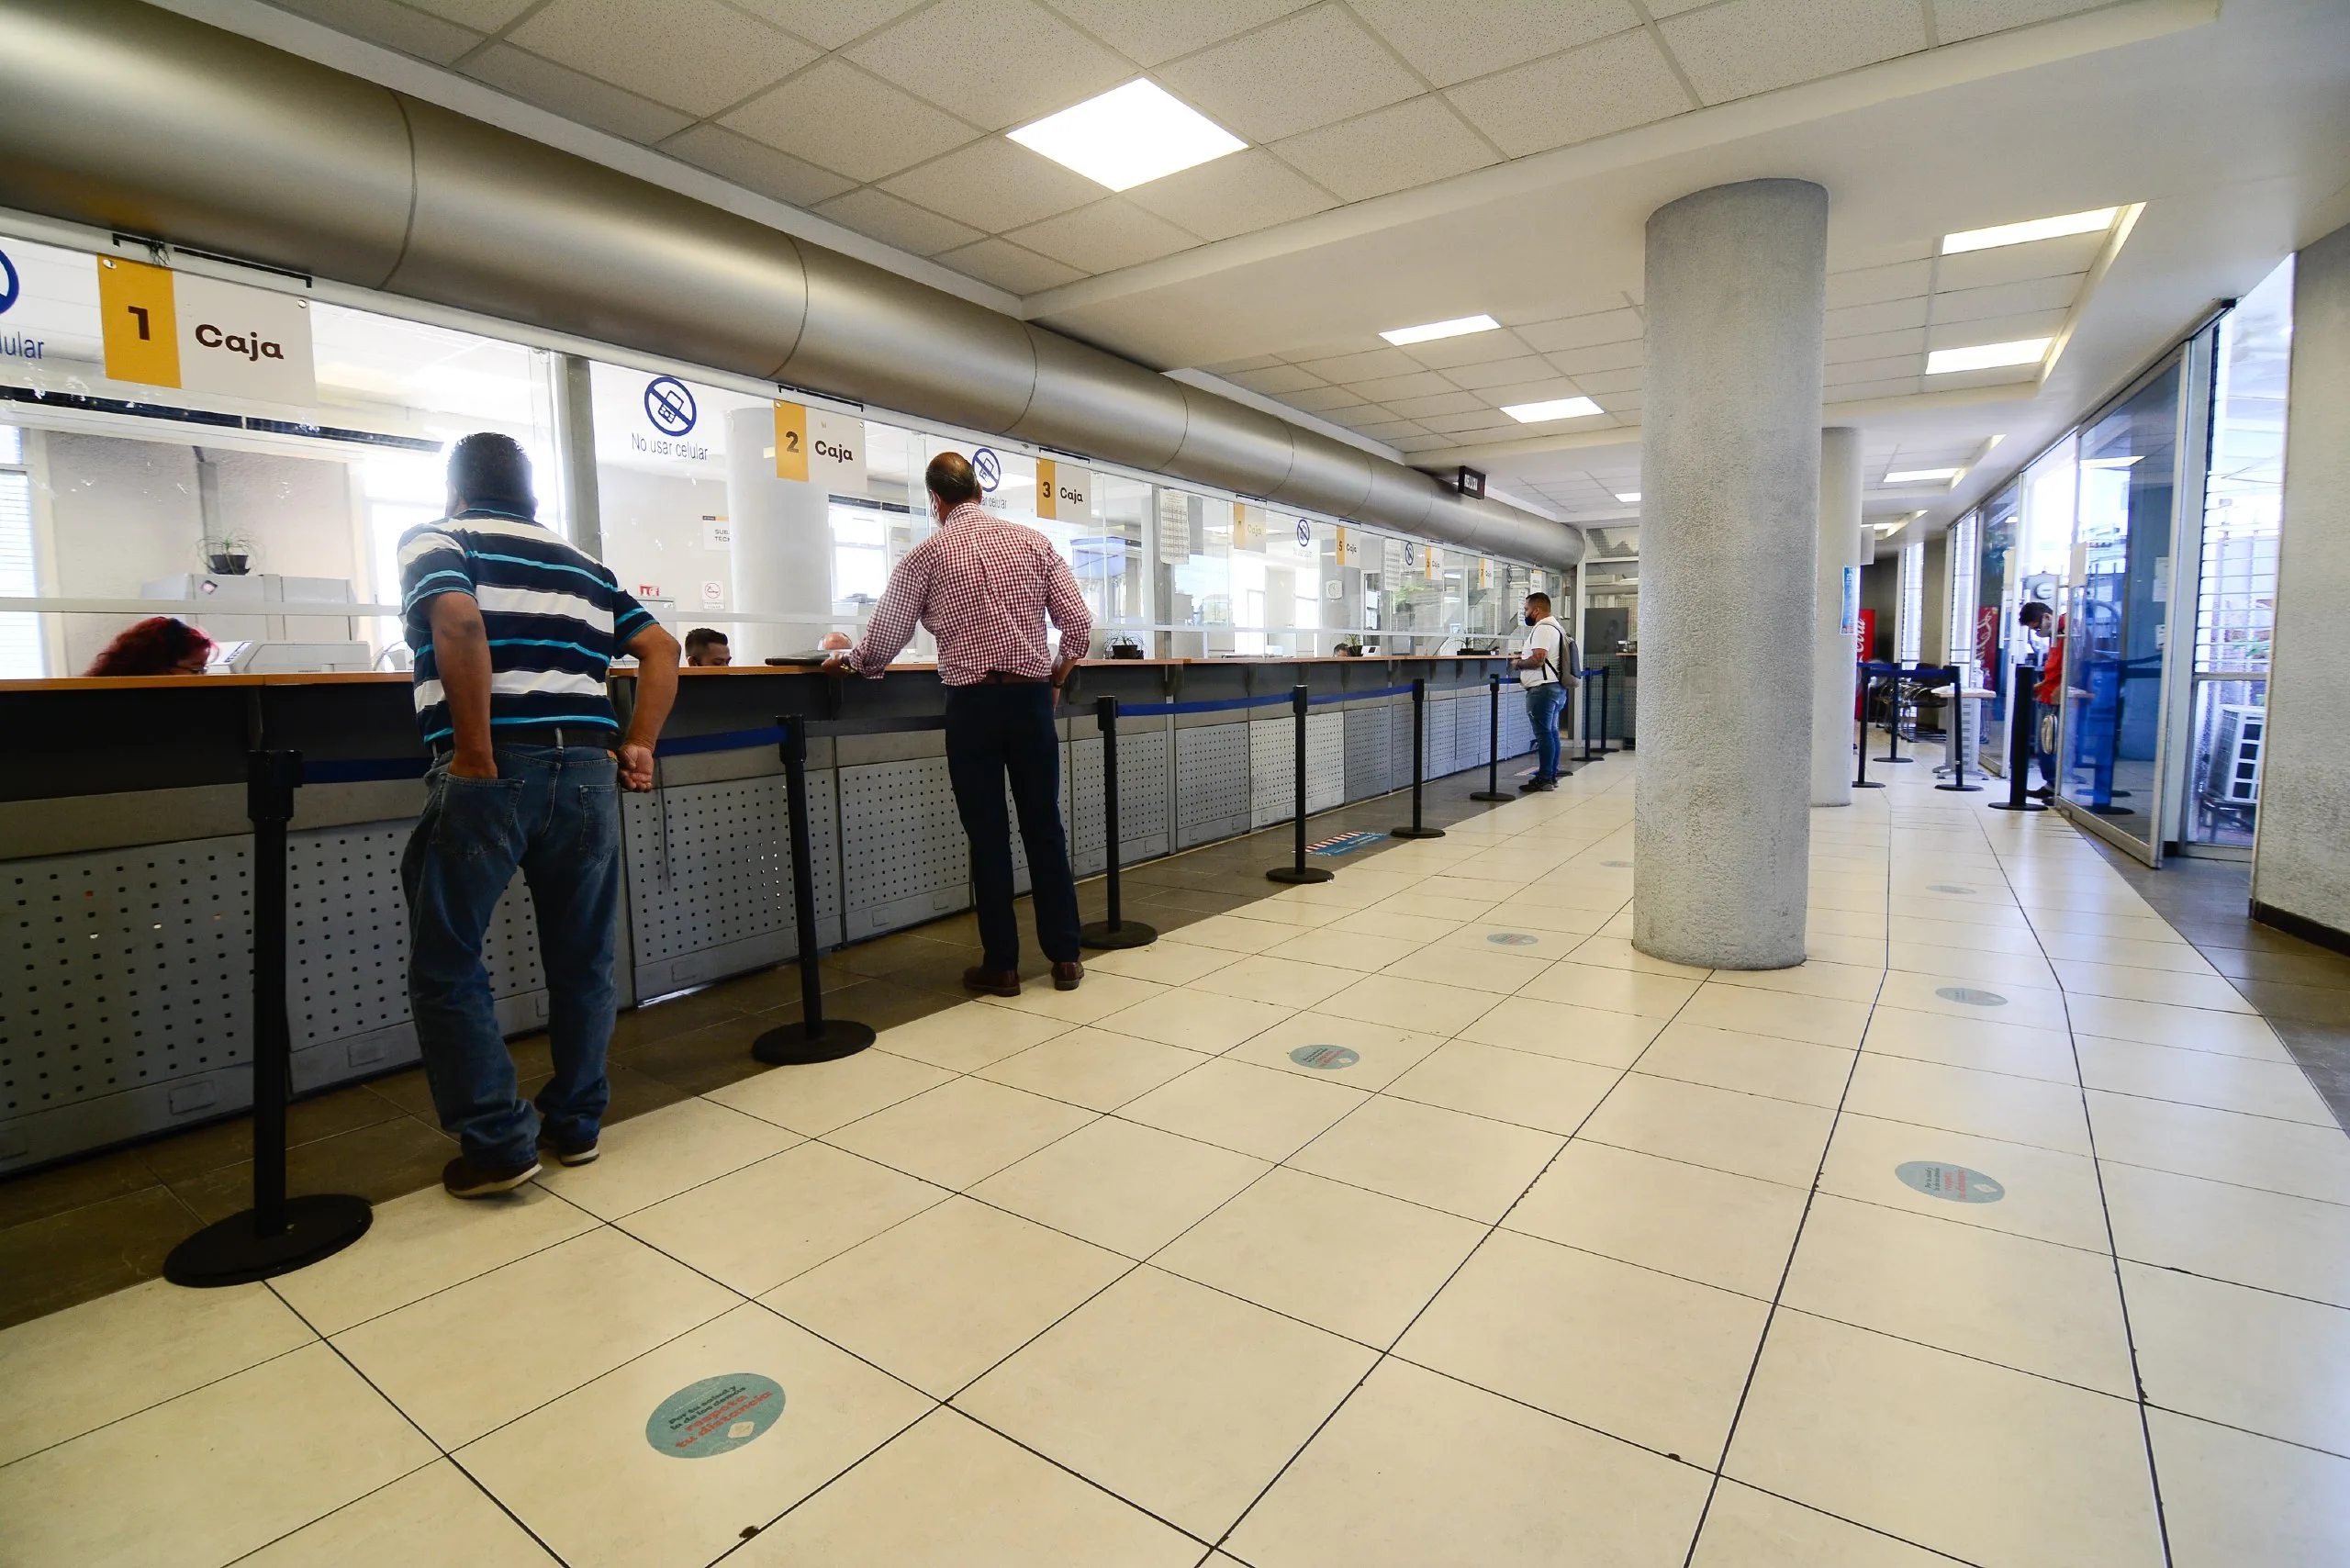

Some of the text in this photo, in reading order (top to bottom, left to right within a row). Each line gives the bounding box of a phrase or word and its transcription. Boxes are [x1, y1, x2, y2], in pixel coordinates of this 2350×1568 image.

[128, 306, 150, 341] 1
[196, 324, 284, 362] Caja
[632, 432, 708, 460] No usar celular
[786, 431, 800, 454] 2
[815, 440, 854, 464] Caja
[1043, 481, 1051, 498] 3
[1060, 487, 1083, 504] Caja
[989, 496, 1007, 510] celular
[1338, 541, 1343, 551] 5
[1347, 543, 1357, 554] Caja
[668, 1412, 687, 1425] Por
[698, 1390, 773, 1437] distancia
